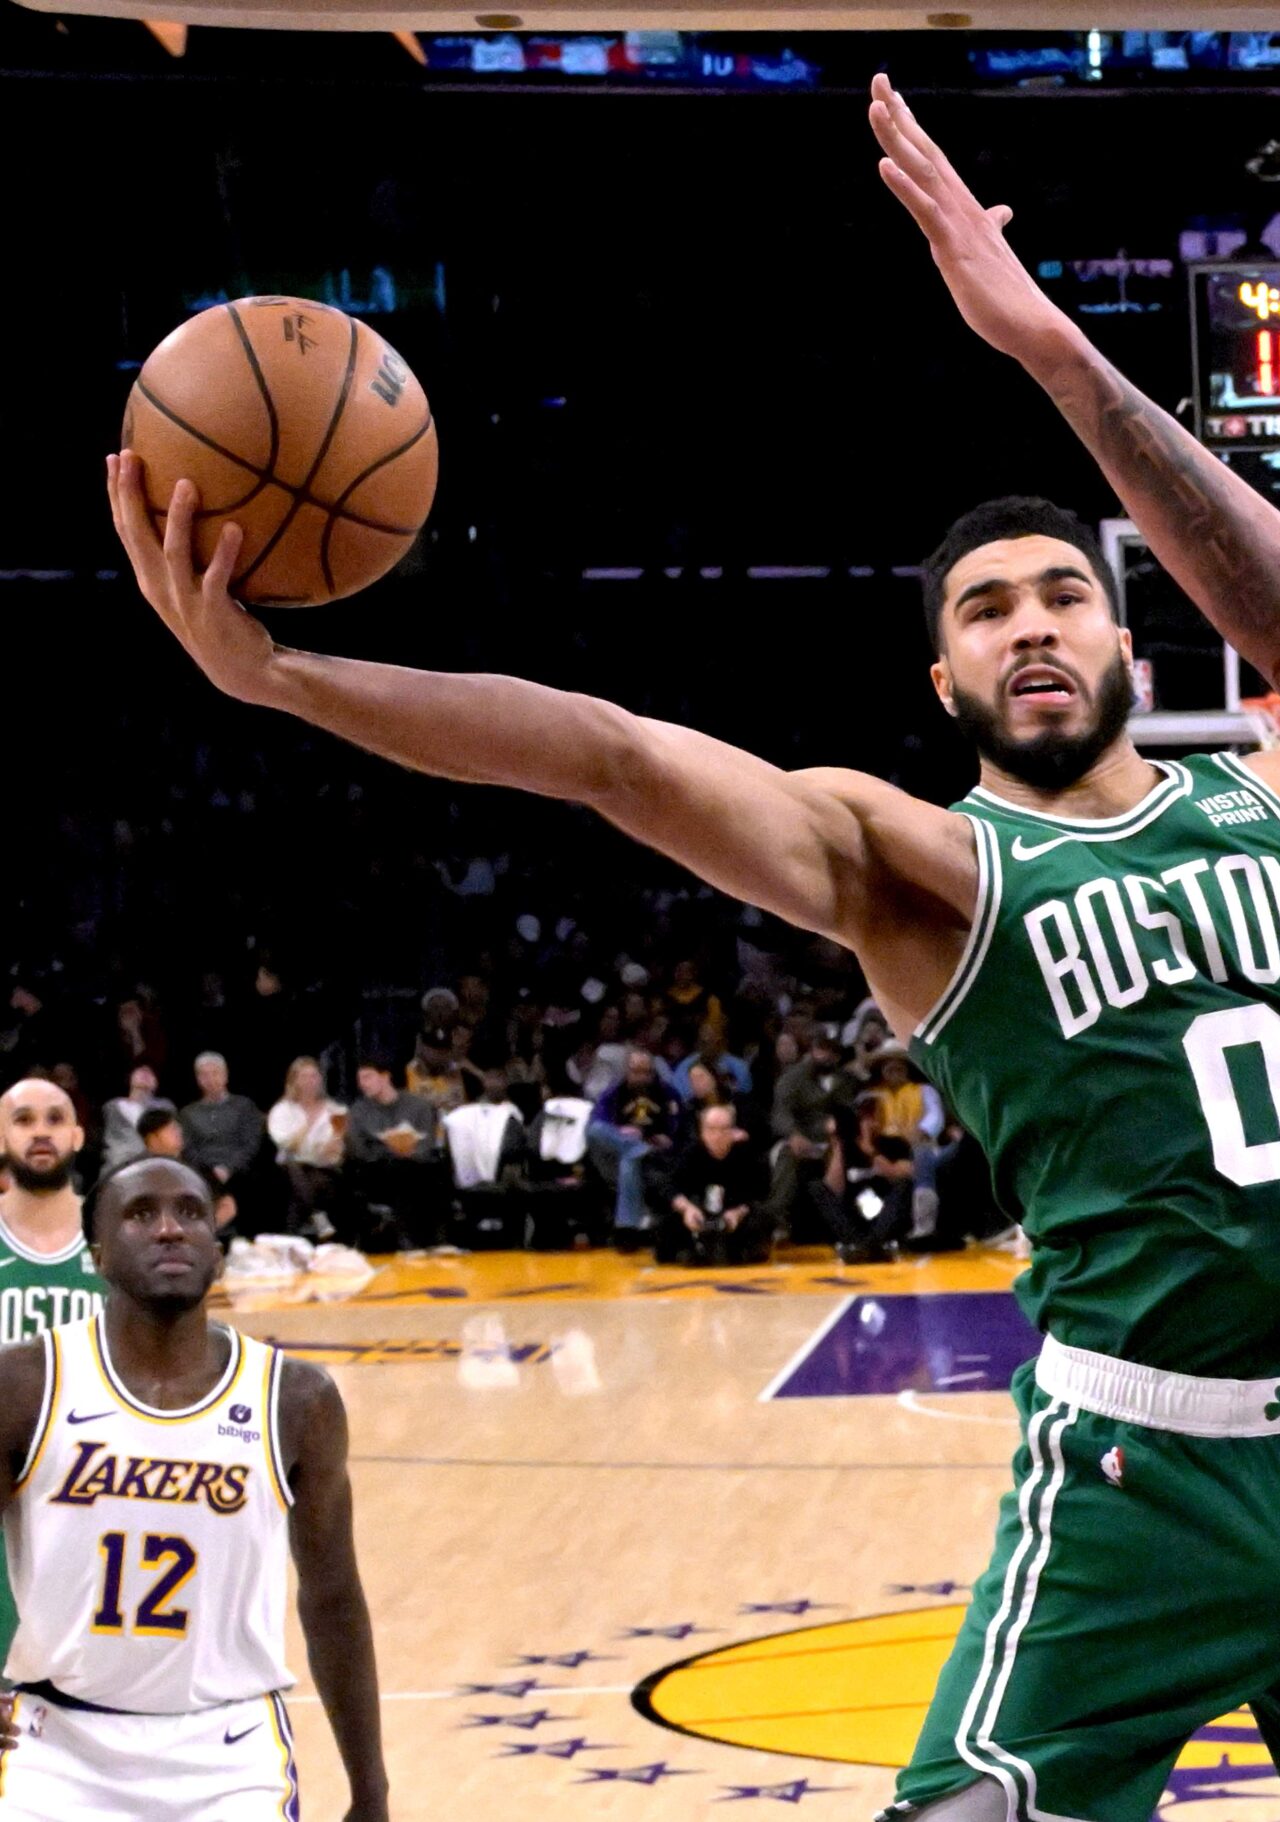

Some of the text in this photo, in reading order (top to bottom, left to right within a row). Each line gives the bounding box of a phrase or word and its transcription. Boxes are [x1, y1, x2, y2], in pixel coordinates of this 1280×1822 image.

[1194, 790, 1261, 815] VISTA
[1207, 805, 1269, 828] PRINT
[217, 1423, 261, 1444] bibigo
[50, 1439, 251, 1517] LAKERS
[88, 1528, 198, 1641] 12
